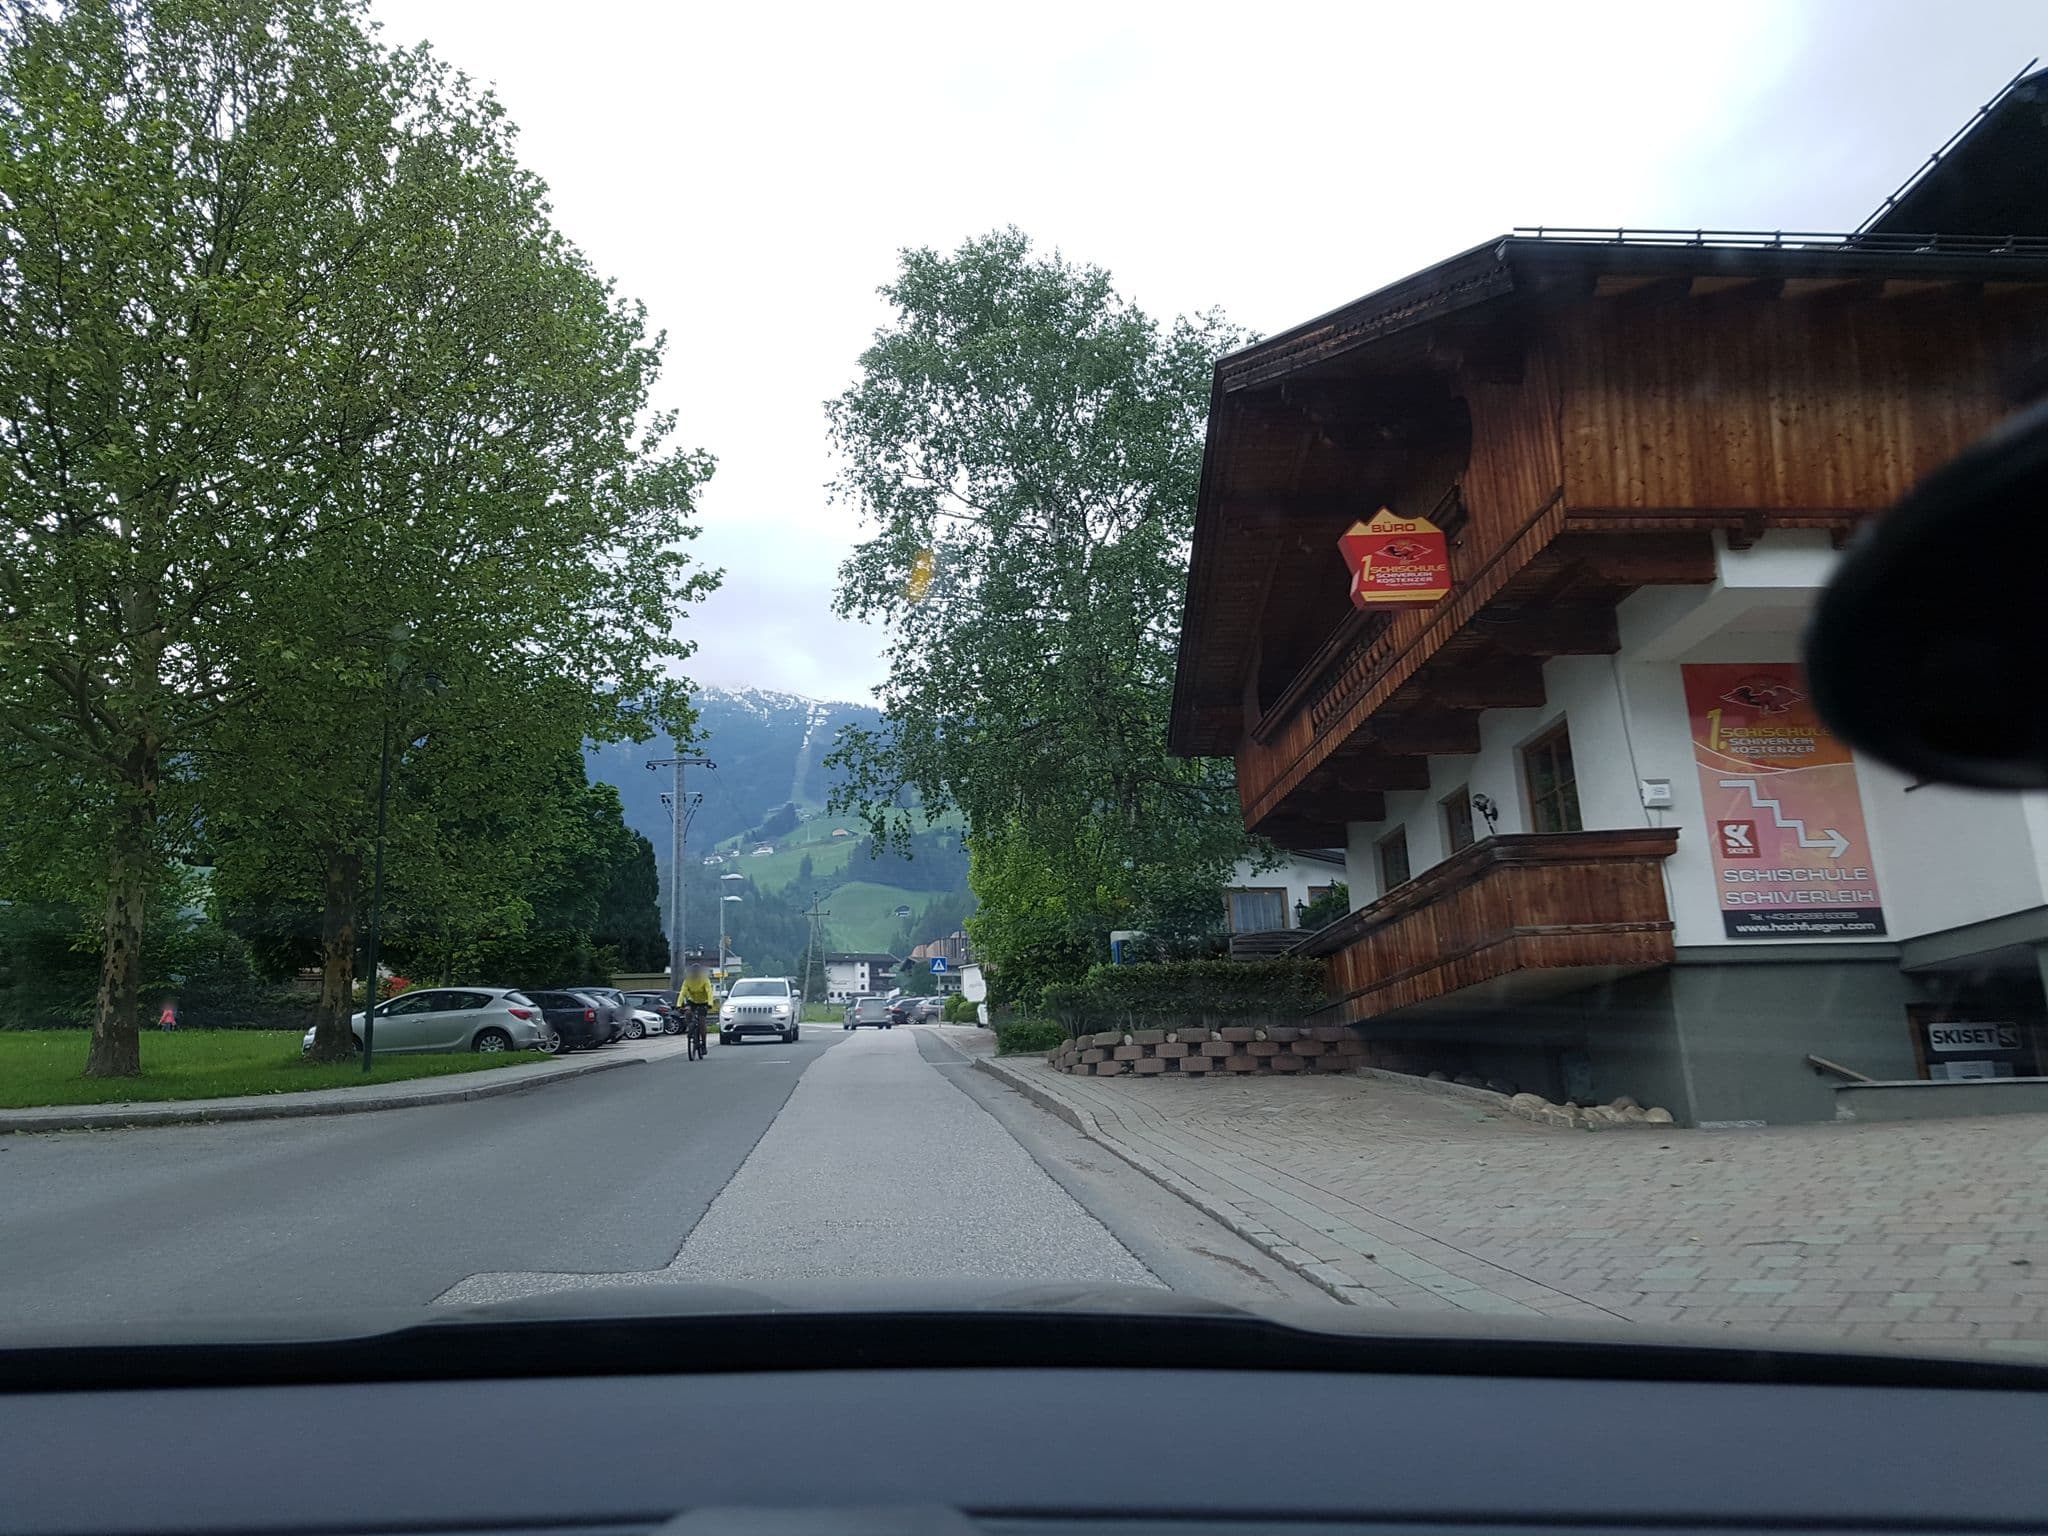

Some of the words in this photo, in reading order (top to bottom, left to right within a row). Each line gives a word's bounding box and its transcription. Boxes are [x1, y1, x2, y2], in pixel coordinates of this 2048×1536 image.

[1371, 521, 1416, 533] BÜRO
[1361, 554, 1376, 582] 1.
[1370, 564, 1447, 574] SCHISCHULE
[1706, 708, 1728, 751] 1.
[1720, 727, 1834, 738] SCHISCHULE
[1729, 737, 1815, 746] SCHIVERLEIH
[1731, 745, 1817, 754] KOSTENZER
[1723, 868, 1868, 884] SCHISCHULE
[1726, 890, 1874, 906] SCHIVERLEIH
[1736, 921, 1876, 933] www.hochfuegen.com
[1932, 1029, 1995, 1045] SKISET
